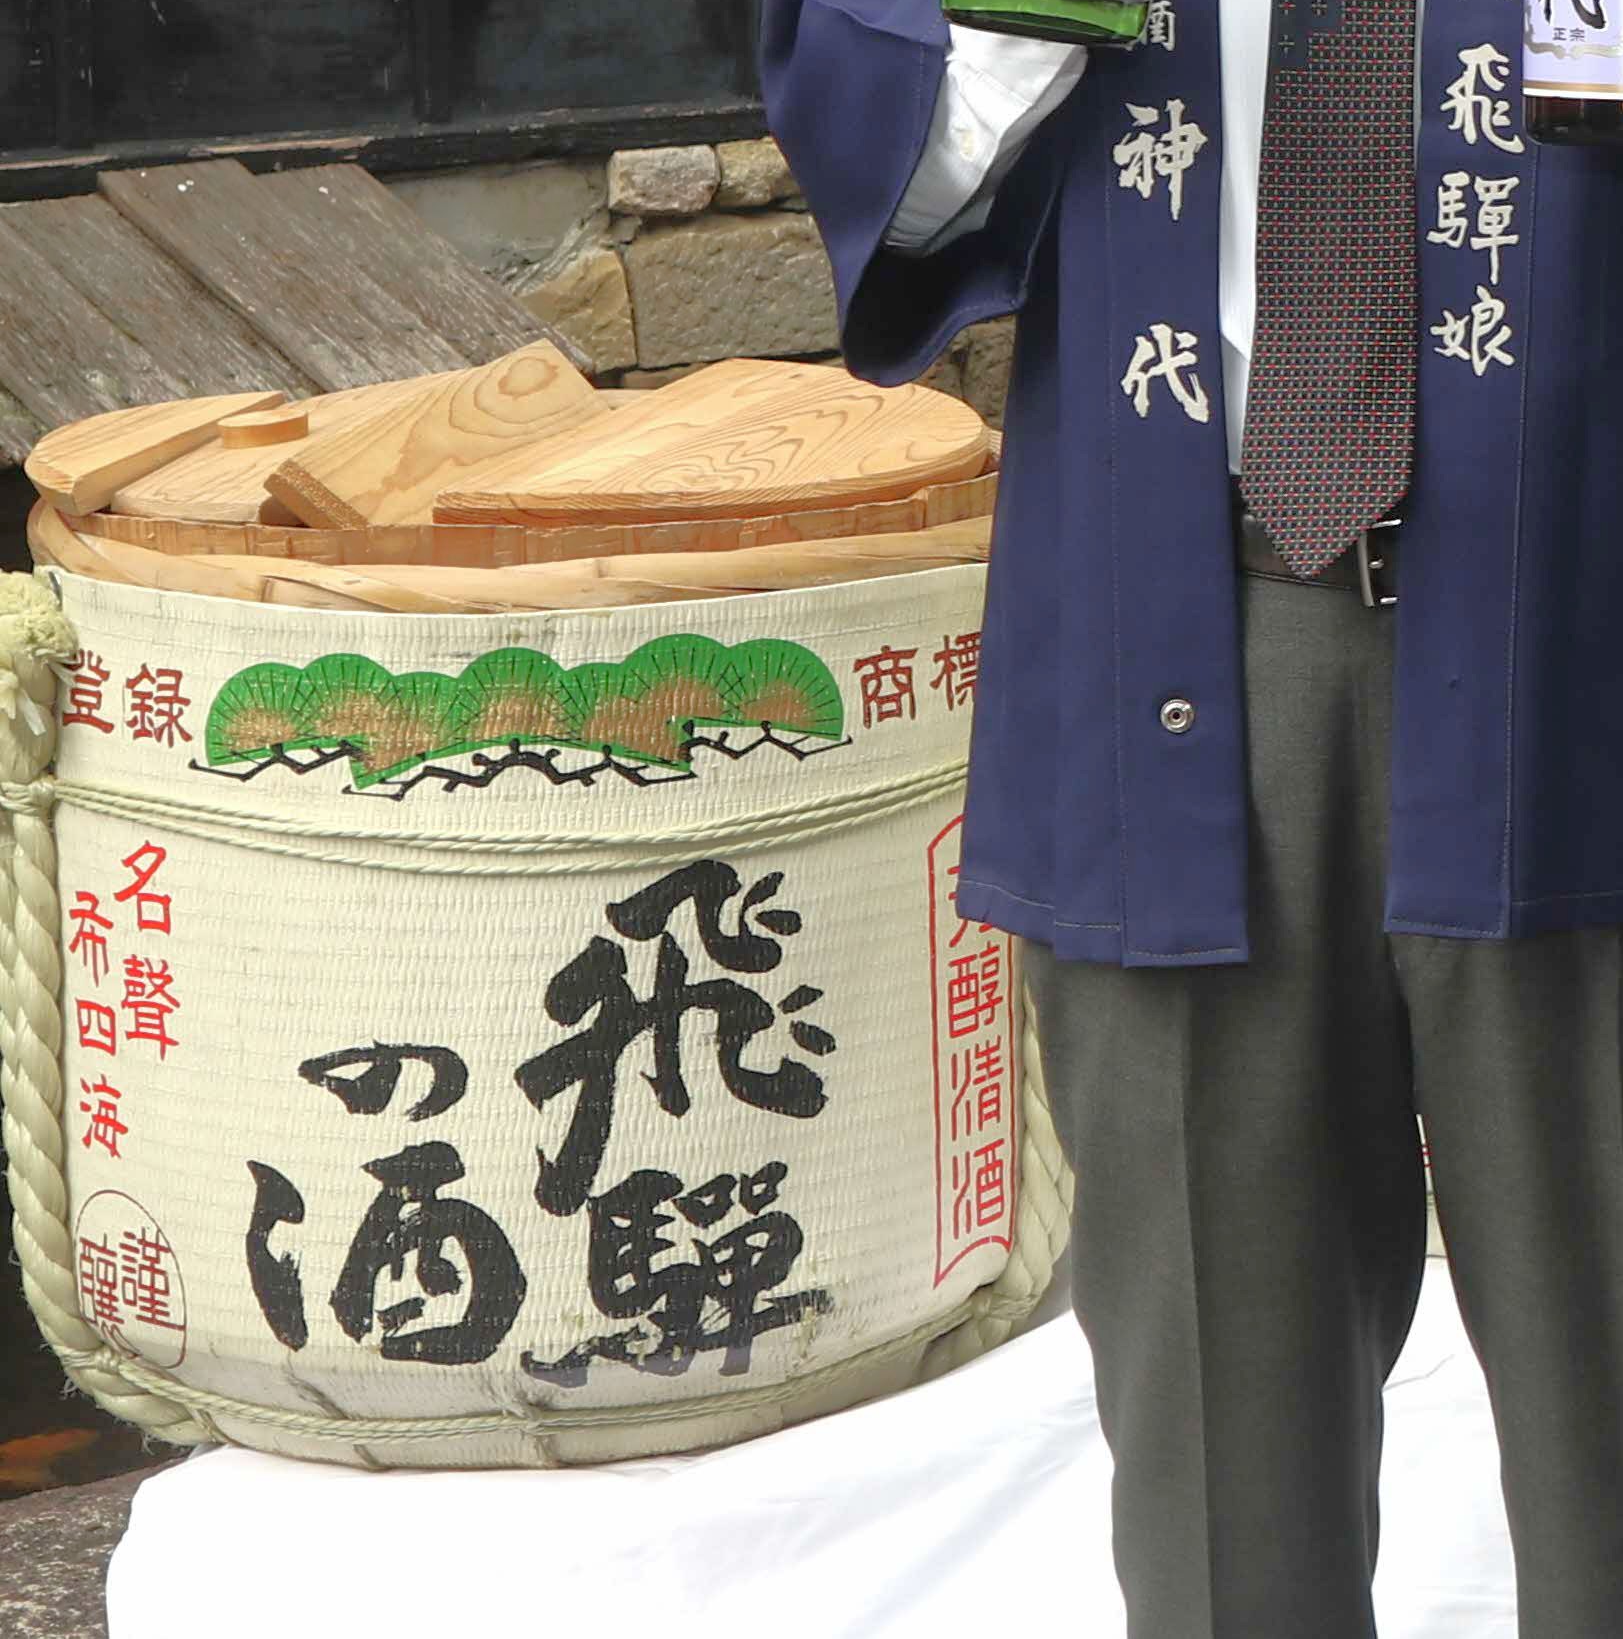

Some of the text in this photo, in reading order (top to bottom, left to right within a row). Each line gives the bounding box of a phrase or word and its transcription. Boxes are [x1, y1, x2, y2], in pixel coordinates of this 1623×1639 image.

[1552, 27, 1586, 42] 正宗
[1113, 98, 1209, 424] 神代
[62, 649, 192, 748] 登録
[948, 867, 1004, 1240] 醇清酒
